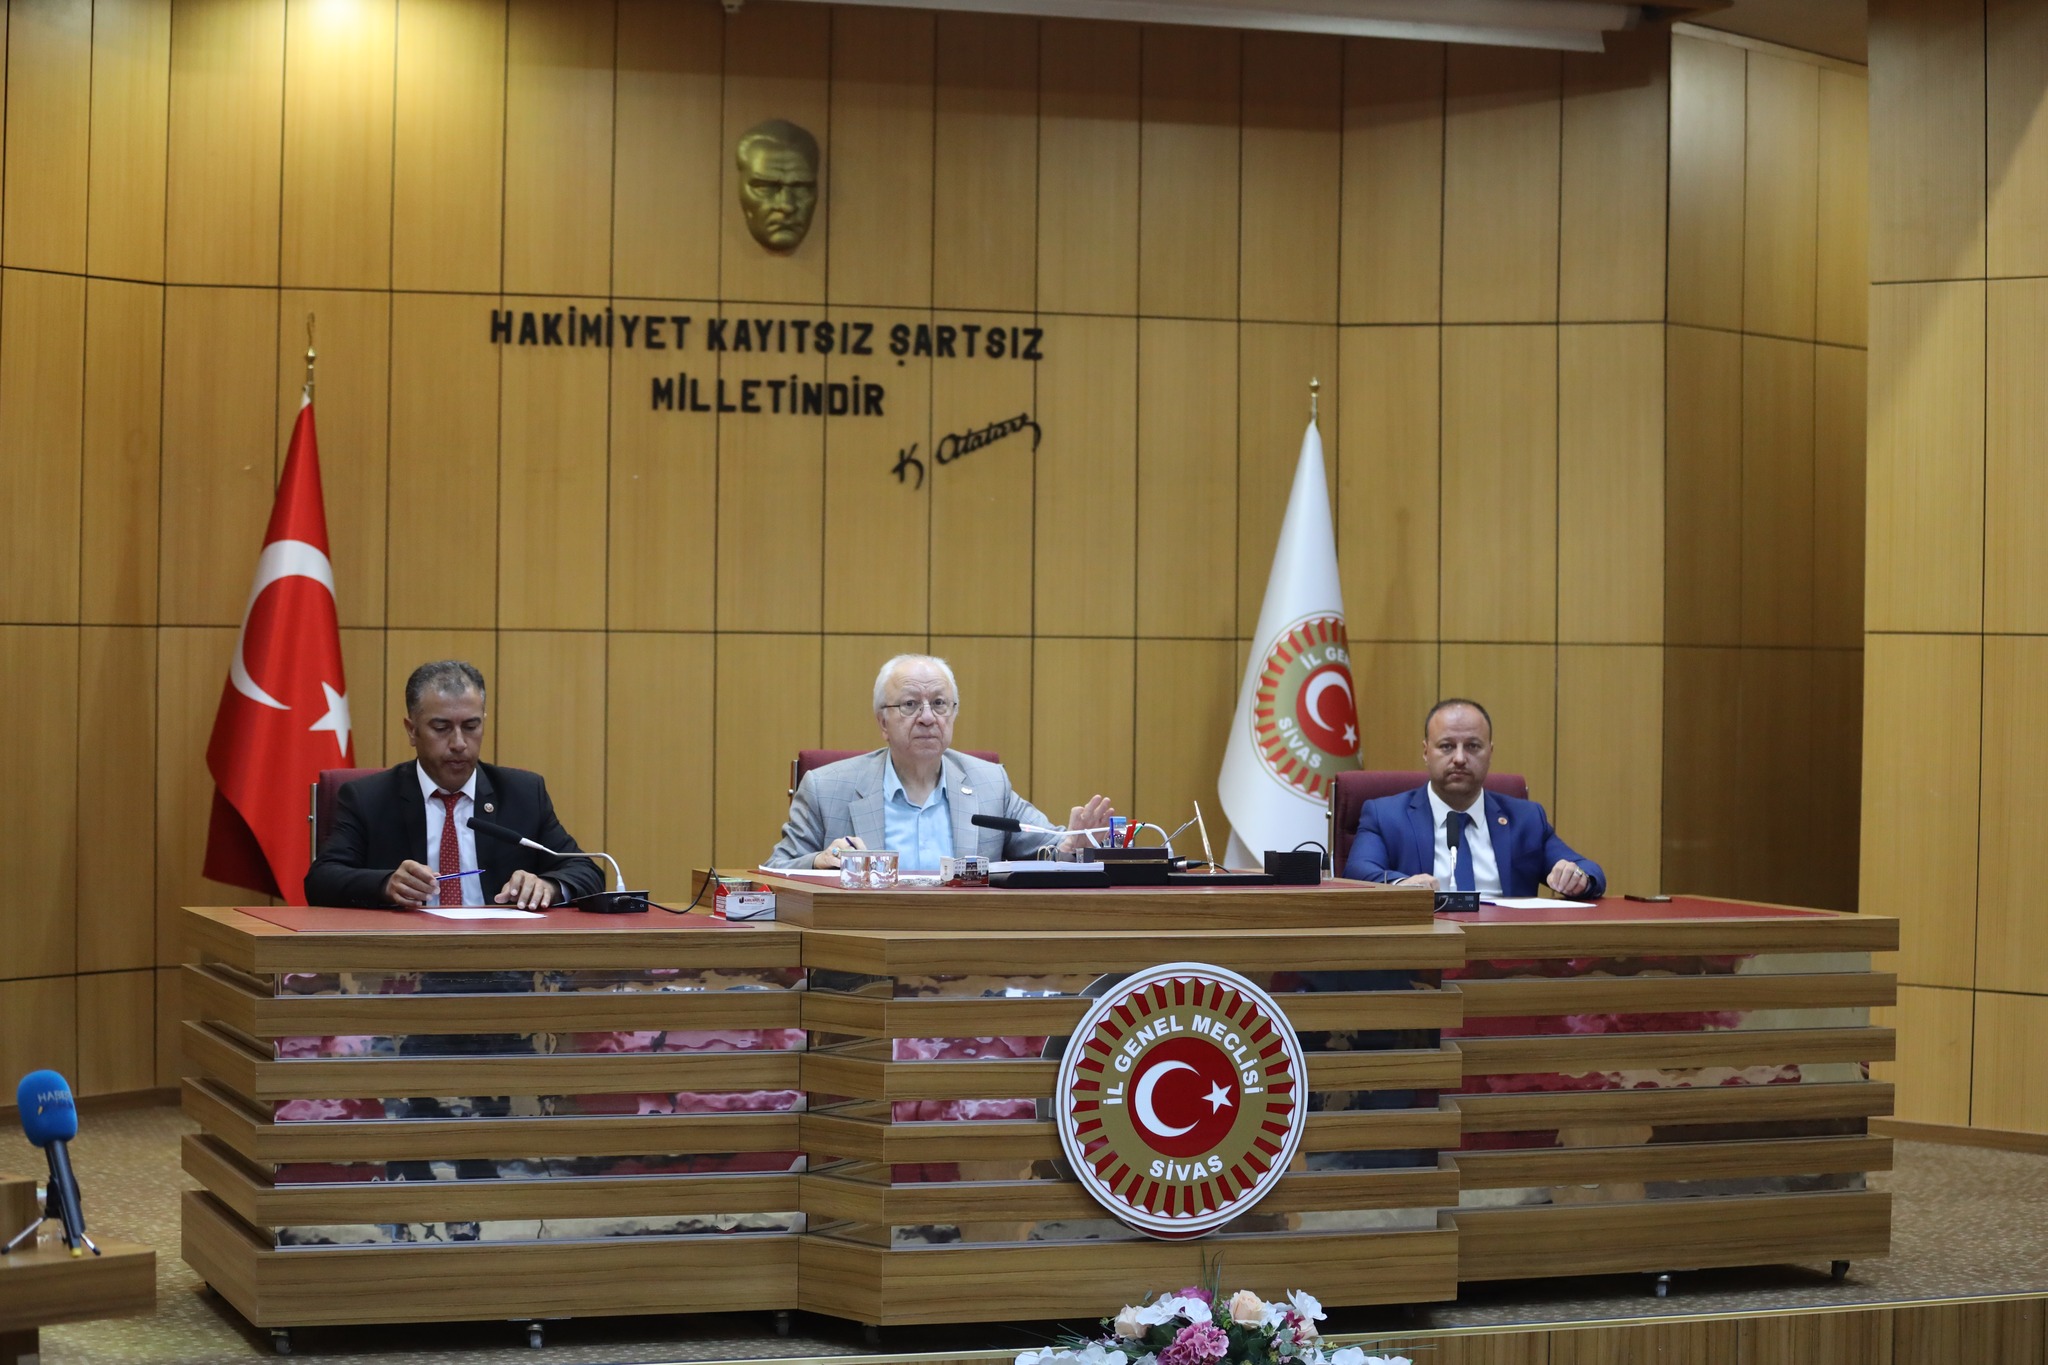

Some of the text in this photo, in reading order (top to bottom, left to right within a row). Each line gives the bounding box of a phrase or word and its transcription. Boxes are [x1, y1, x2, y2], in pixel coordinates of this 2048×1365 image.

[490, 306, 1044, 366] HAKİMİYET KAYITSIZ ŞARTSIZ
[652, 373, 885, 416] MİLLETİNDİR
[1279, 716, 1322, 768] SİVAS
[1103, 1014, 1264, 1105] İL GENEL MECLİSİ
[1149, 1155, 1223, 1182] SİVAS
